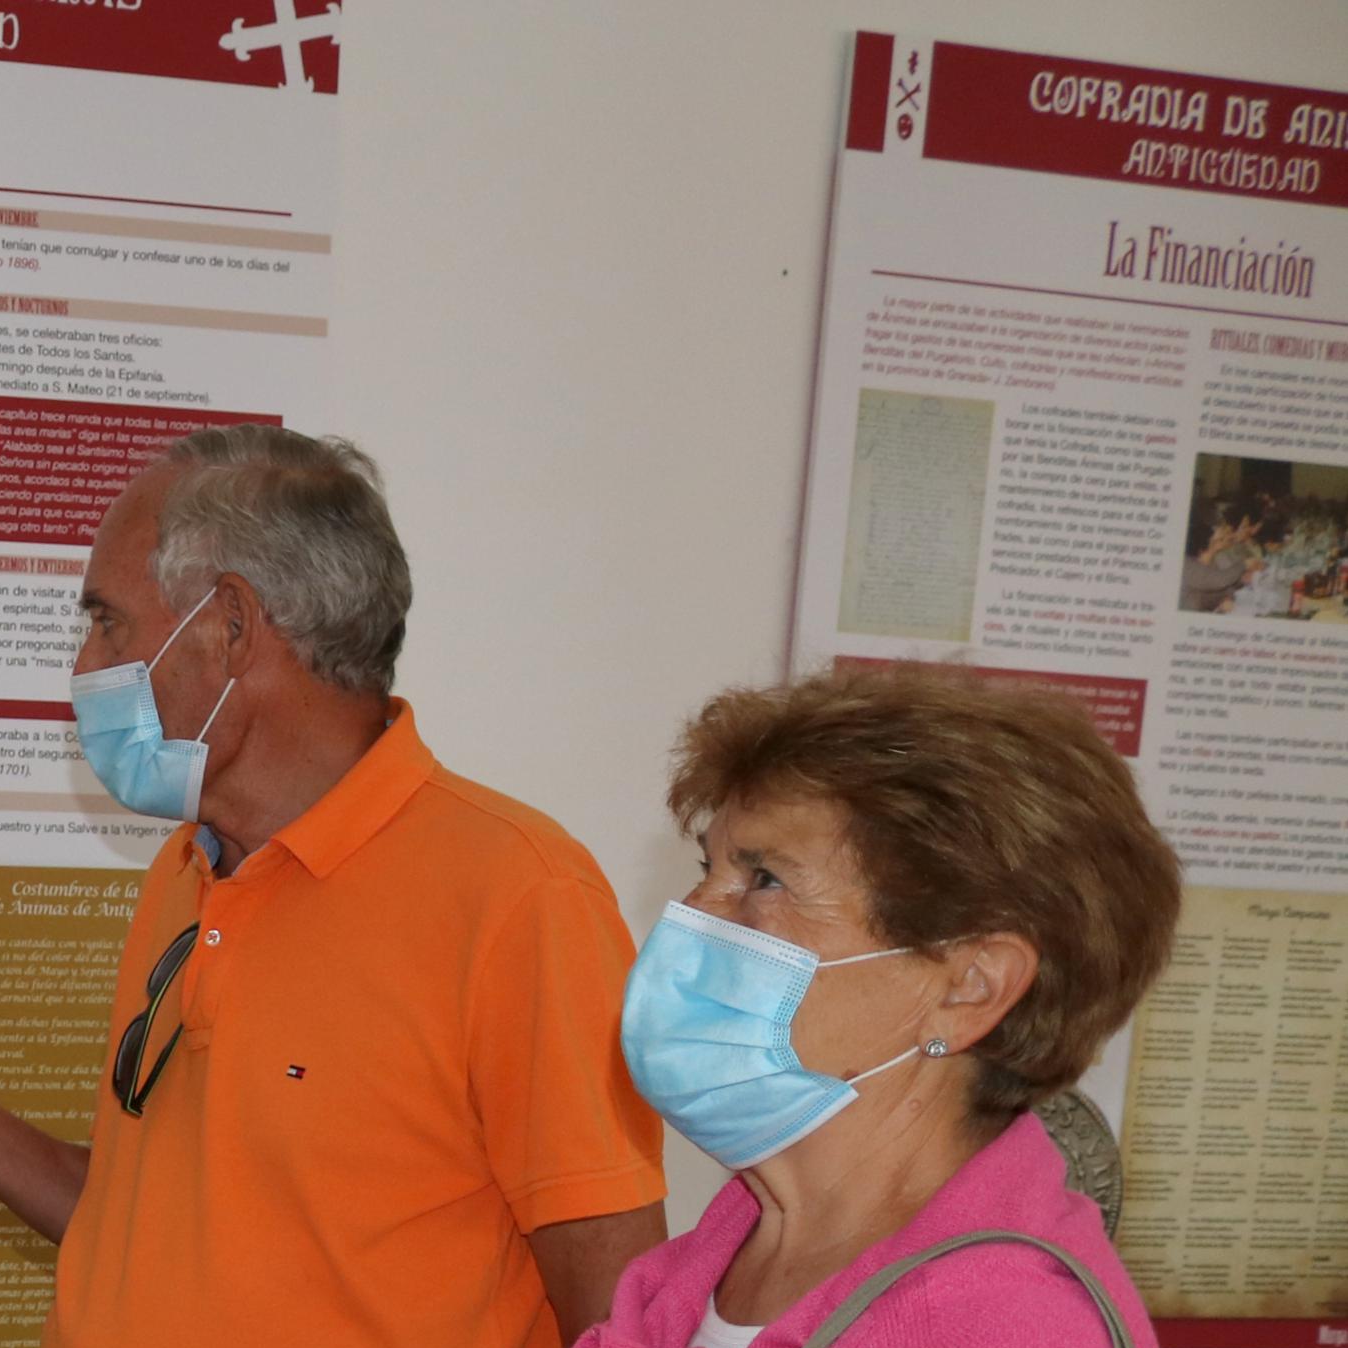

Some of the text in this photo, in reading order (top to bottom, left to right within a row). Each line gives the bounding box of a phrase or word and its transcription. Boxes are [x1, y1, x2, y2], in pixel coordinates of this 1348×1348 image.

[1223, 96, 1269, 139] DE
[1104, 220, 1315, 298] La Financiación
[19, 296, 69, 316] NOCTURNOS
[12, 880, 139, 898] Costumbres de la
[73, 900, 91, 916] de
